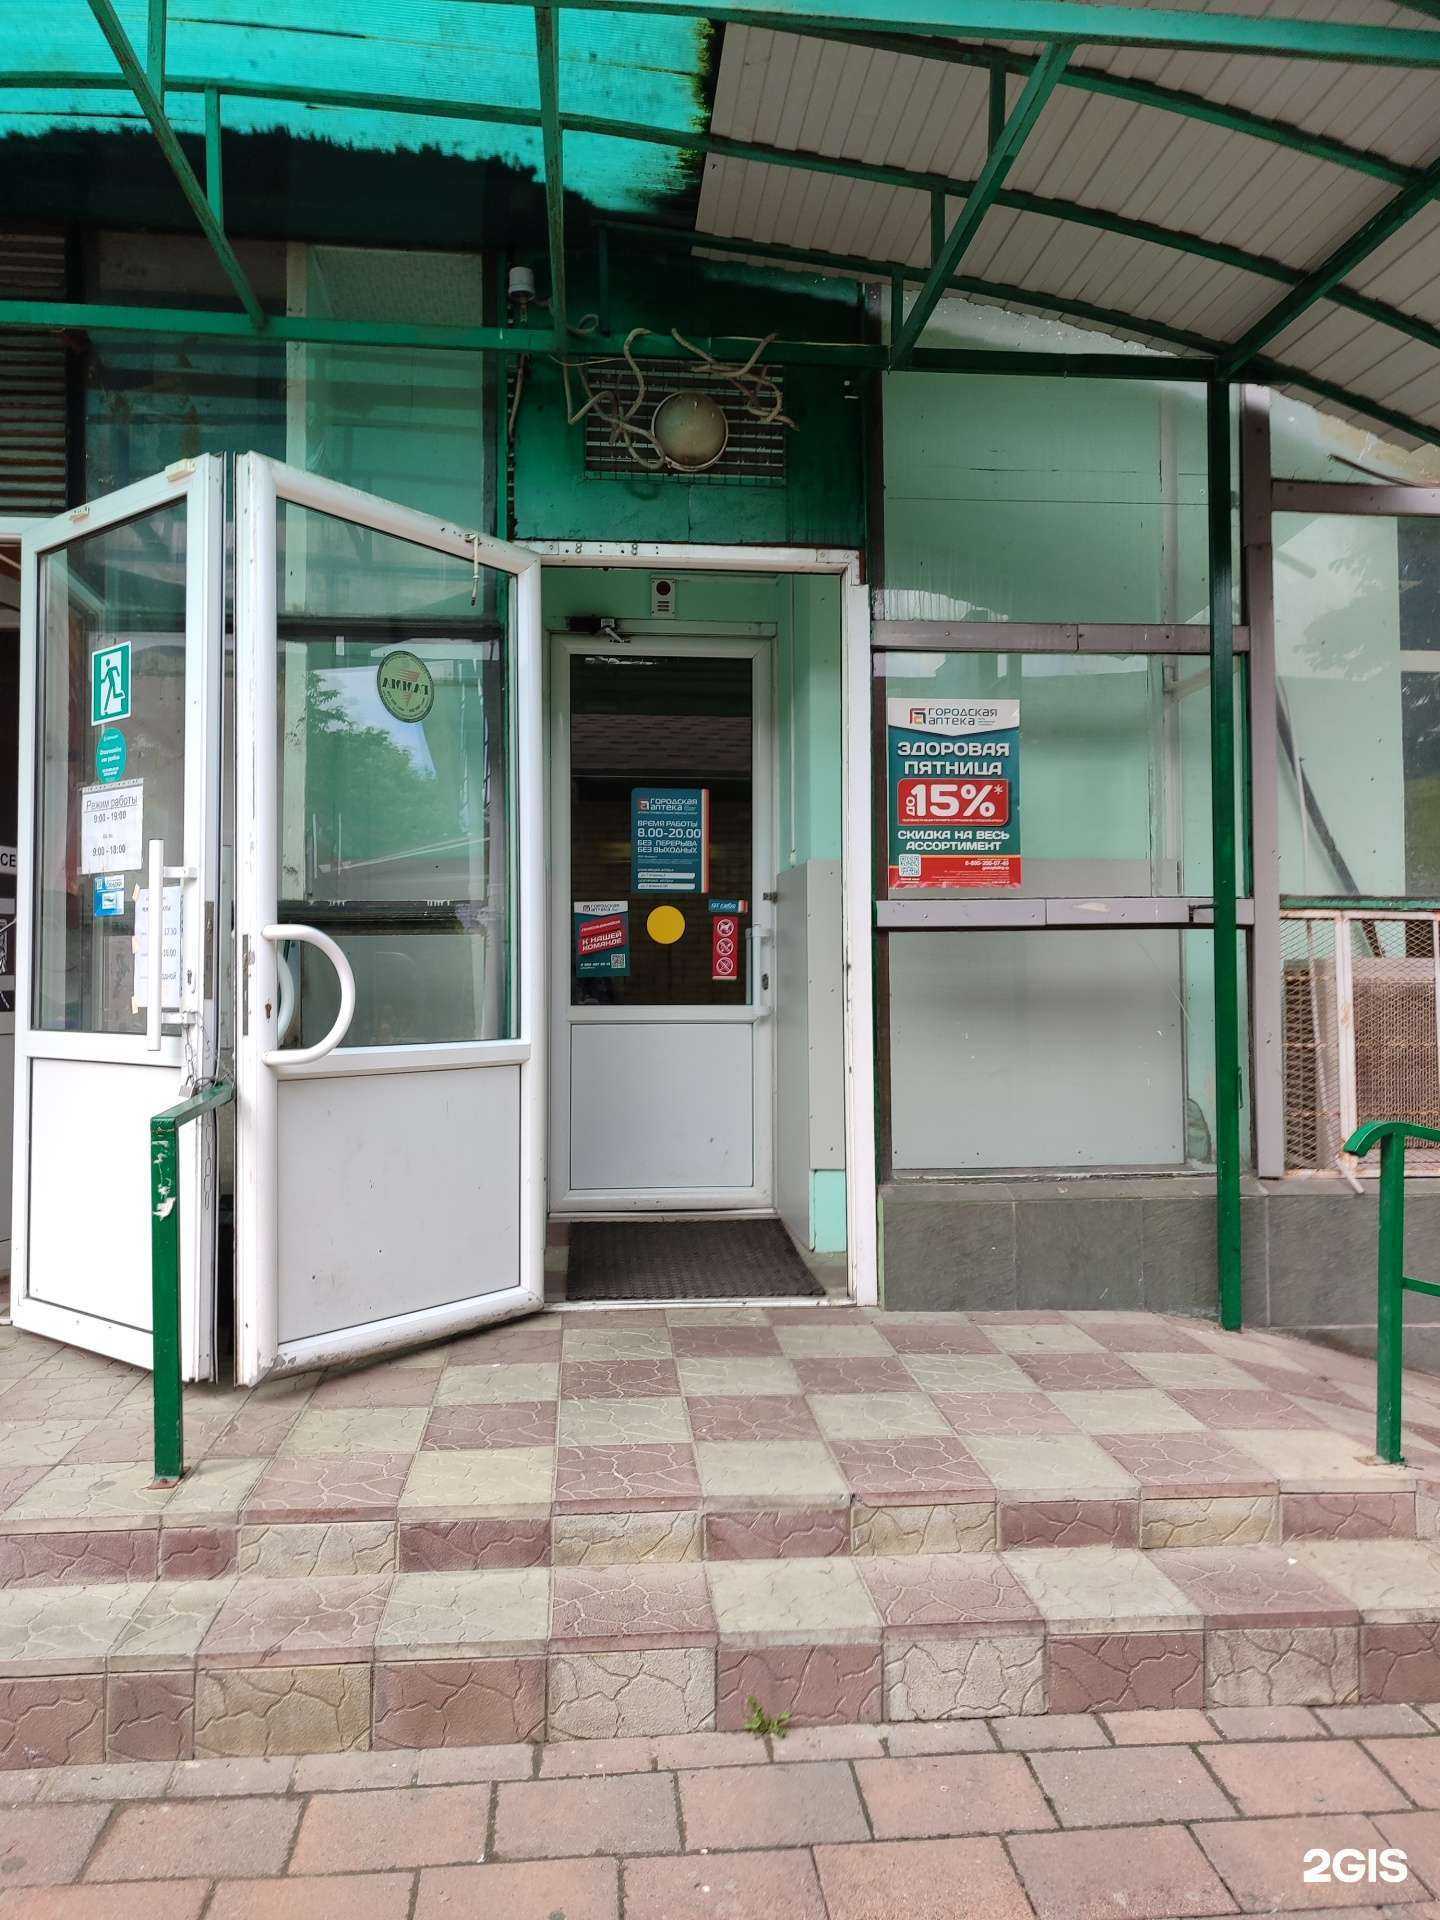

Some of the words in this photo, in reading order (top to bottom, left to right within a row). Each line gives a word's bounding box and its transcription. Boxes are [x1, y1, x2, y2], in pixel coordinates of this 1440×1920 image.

[897, 741, 1010, 757] ЗДОРОВАЯ
[904, 760, 1002, 775] ПЯТНИЦА
[86, 799, 110, 811] Режим
[110, 795, 138, 810] работы
[906, 796, 916, 816] ДО
[637, 819, 665, 827] ВРЕМЯ
[666, 819, 698, 827] РАБОТЫ
[897, 830, 951, 841] СКИДКА
[954, 830, 973, 841] НА
[976, 830, 1010, 841] ВЕСЬ
[637, 839, 652, 847] БЕЗ
[656, 839, 698, 847] ПЕРЕРЫВА
[905, 841, 1002, 852] АССОРТИМЕНТ
[637, 846, 652, 854] БЕЗ
[654, 846, 698, 855] ВЫХОДНЫХ
